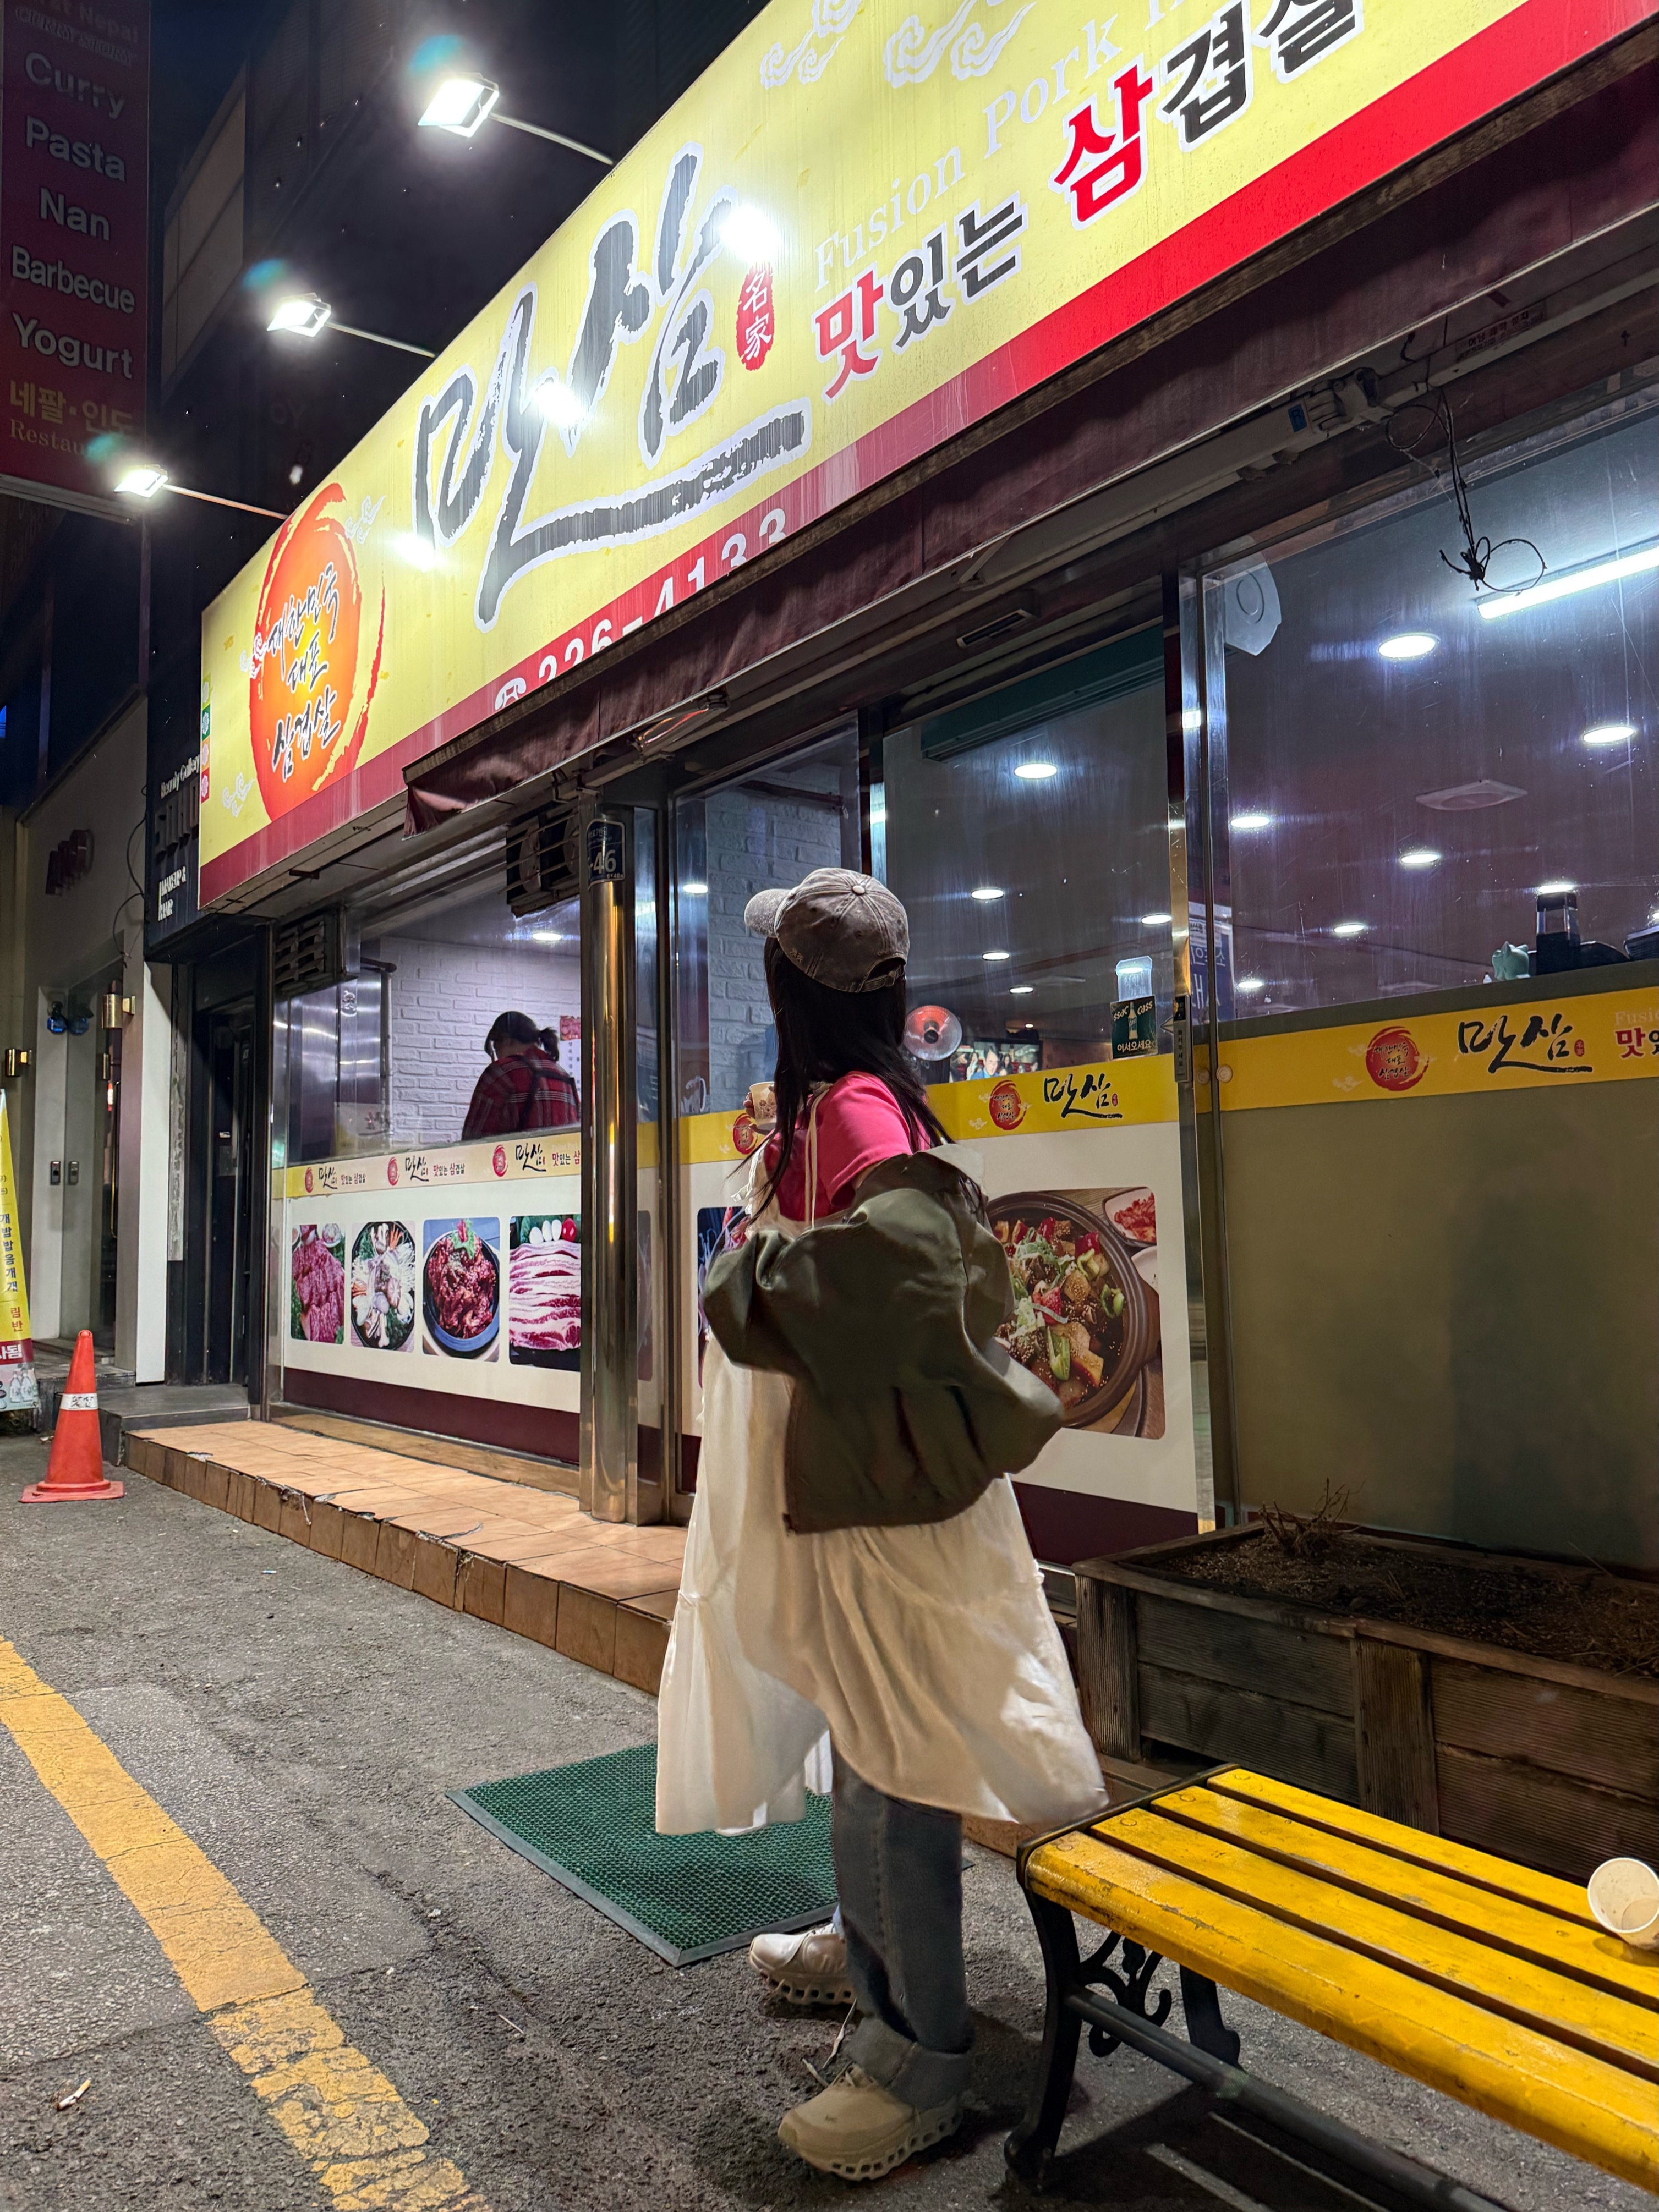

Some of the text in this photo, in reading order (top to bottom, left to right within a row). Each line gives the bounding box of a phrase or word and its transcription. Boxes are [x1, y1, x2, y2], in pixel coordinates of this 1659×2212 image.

[25, 52, 125, 119] Curry
[26, 114, 126, 183] Pasta
[815, 14, 1123, 293] Fusion Pork
[40, 186, 110, 241] Nan
[12, 245, 135, 314] Barbecue
[815, 200, 1024, 400] 맛있는
[12, 311, 133, 380] Yogurt
[266, 562, 340, 680] 대한민국
[287, 631, 327, 693] 대표
[273, 686, 341, 782] 삼겹살
[1116, 1039, 1152, 1053] 어서오세요
[1386, 1054, 1405, 1066] 대표
[552, 1152, 571, 1167] 맛있는
